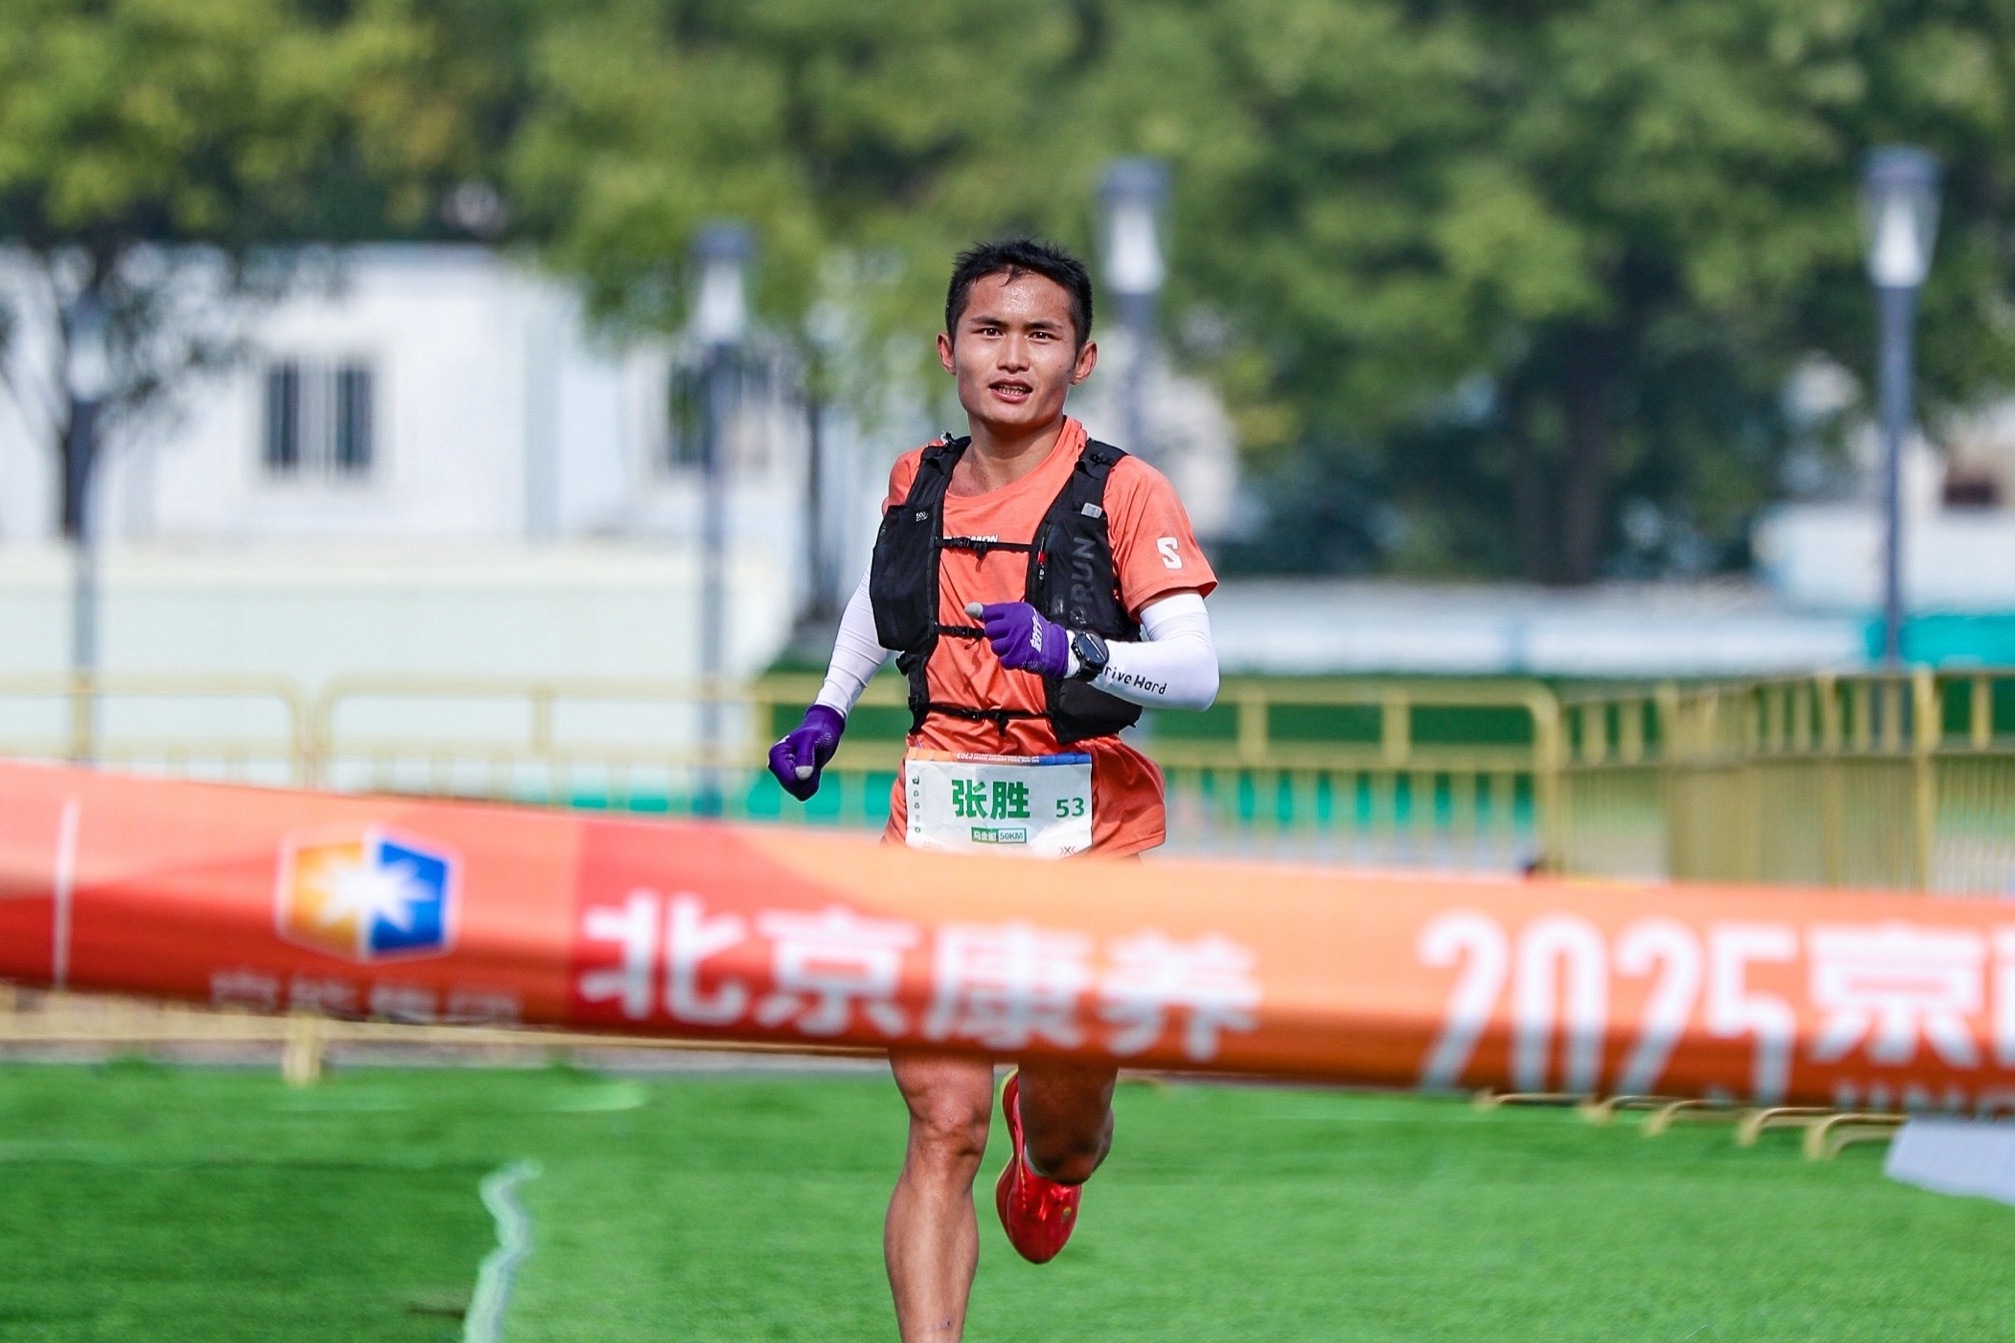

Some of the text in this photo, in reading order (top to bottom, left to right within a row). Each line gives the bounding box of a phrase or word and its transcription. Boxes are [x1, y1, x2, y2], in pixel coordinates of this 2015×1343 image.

[1104, 666, 1168, 695] rive Hard
[951, 779, 1031, 820] 张胜
[1056, 797, 1085, 818] 53
[999, 832, 1023, 840] 50KM
[578, 888, 1263, 1062] 北京康养
